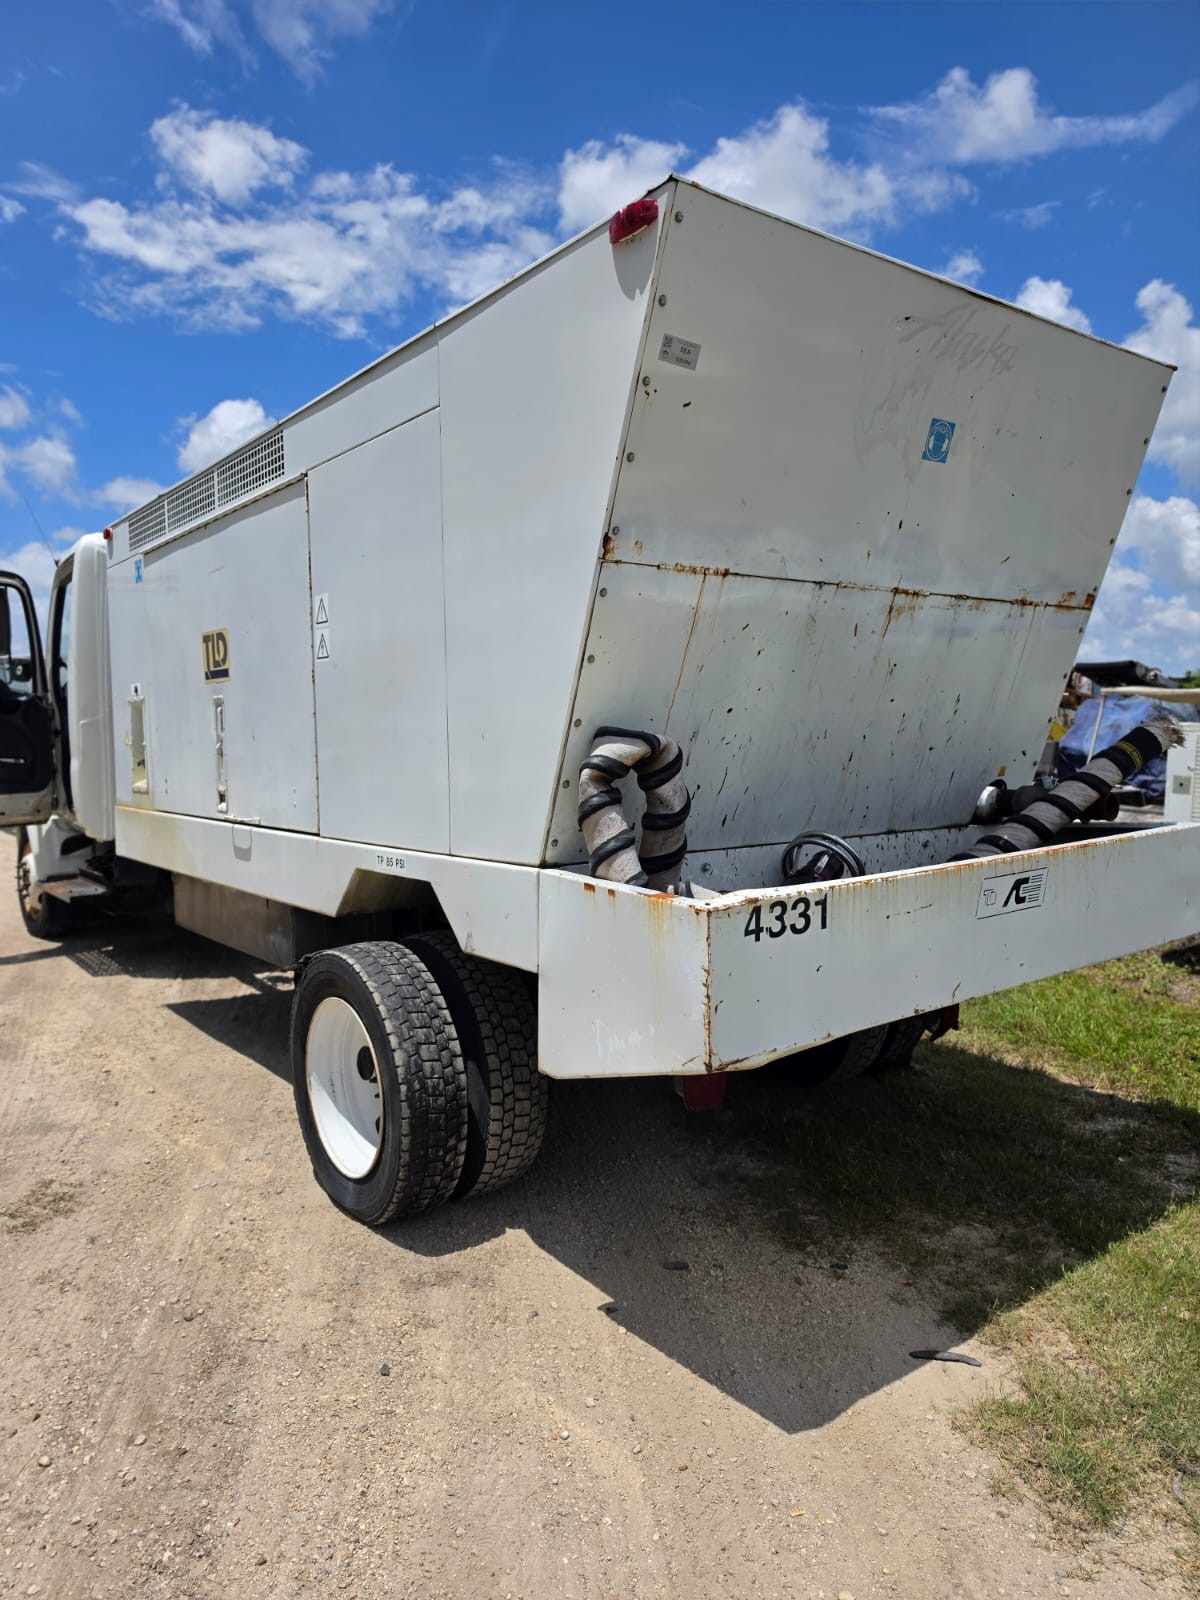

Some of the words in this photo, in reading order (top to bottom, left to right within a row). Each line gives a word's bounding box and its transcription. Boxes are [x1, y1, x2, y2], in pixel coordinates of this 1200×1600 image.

[202, 631, 228, 676] TLD
[377, 855, 384, 865] TP
[395, 858, 406, 870] PSI
[744, 893, 828, 943] 4331
